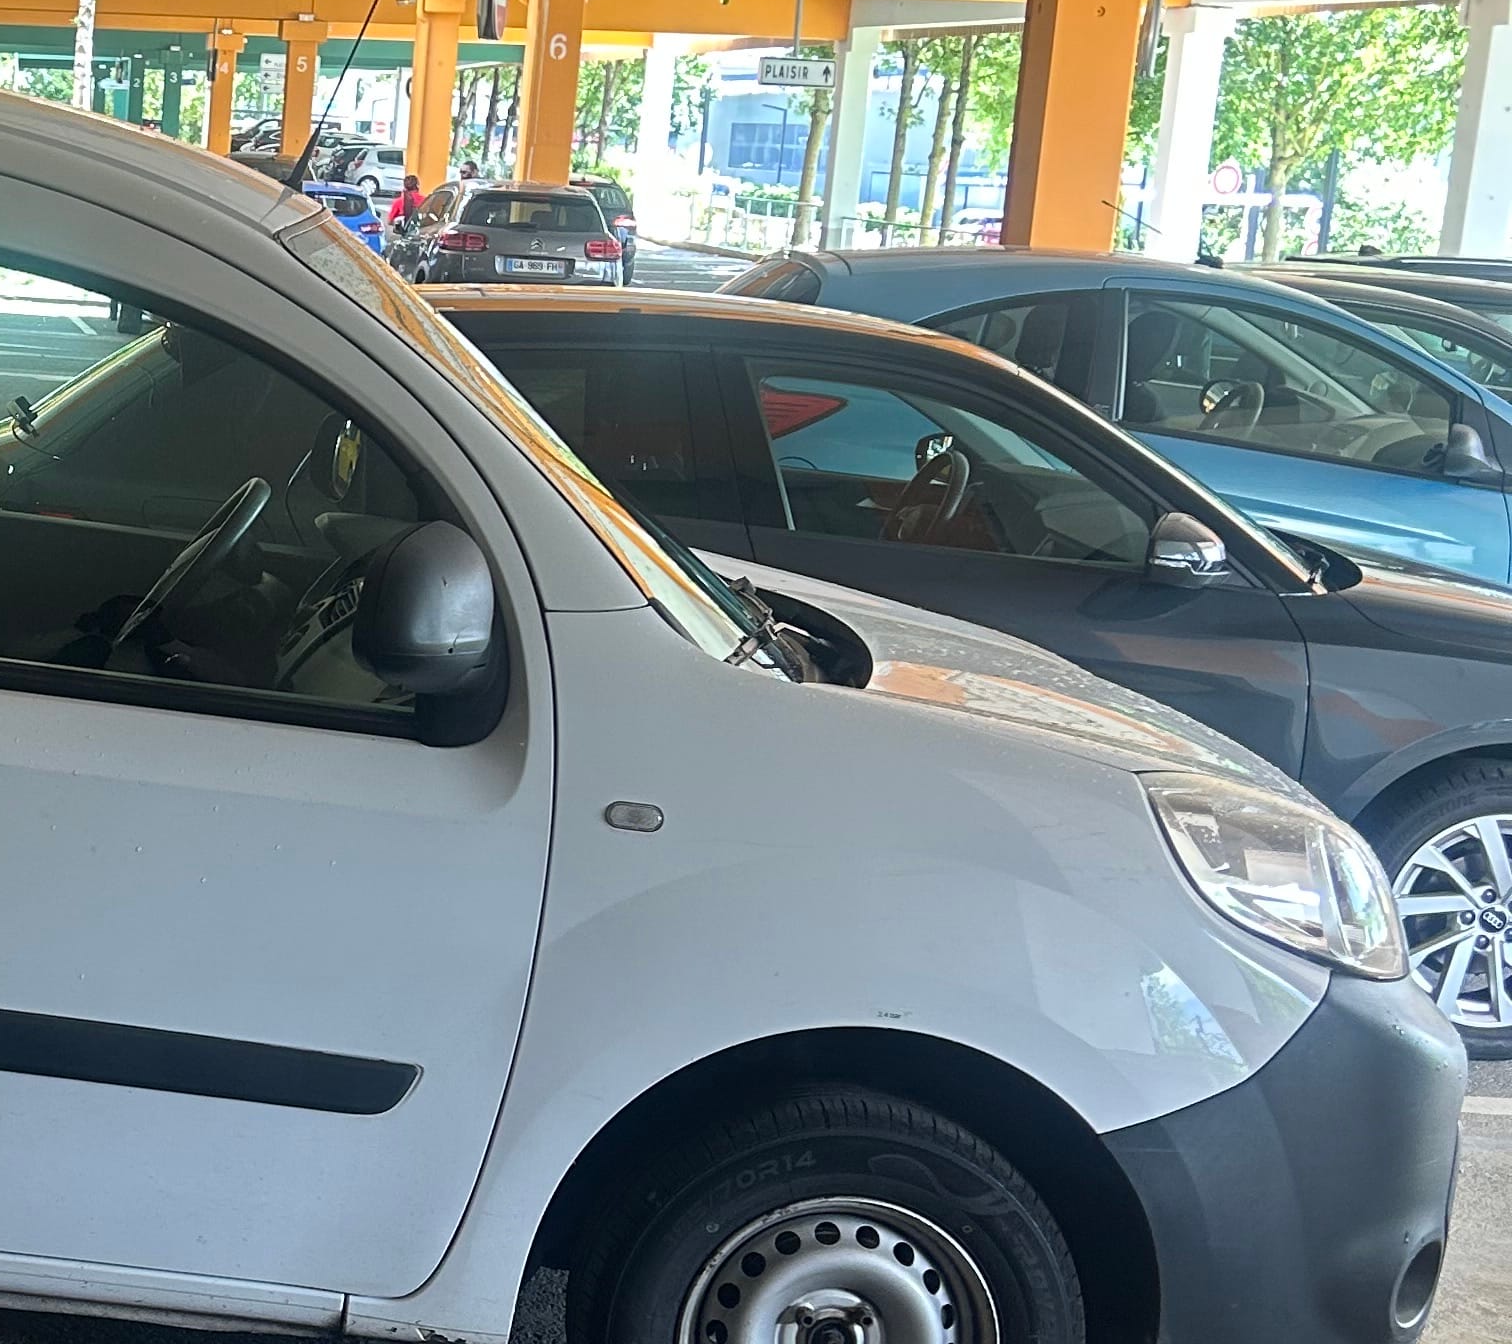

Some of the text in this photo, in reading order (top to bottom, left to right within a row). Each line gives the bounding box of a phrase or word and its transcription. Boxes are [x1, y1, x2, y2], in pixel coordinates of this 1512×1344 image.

[549, 33, 568, 61] 6
[219, 62, 229, 74] 4
[296, 56, 308, 72] 5
[169, 71, 178, 83] 3
[765, 64, 809, 80] PLAISIR
[133, 77, 141, 88] 2
